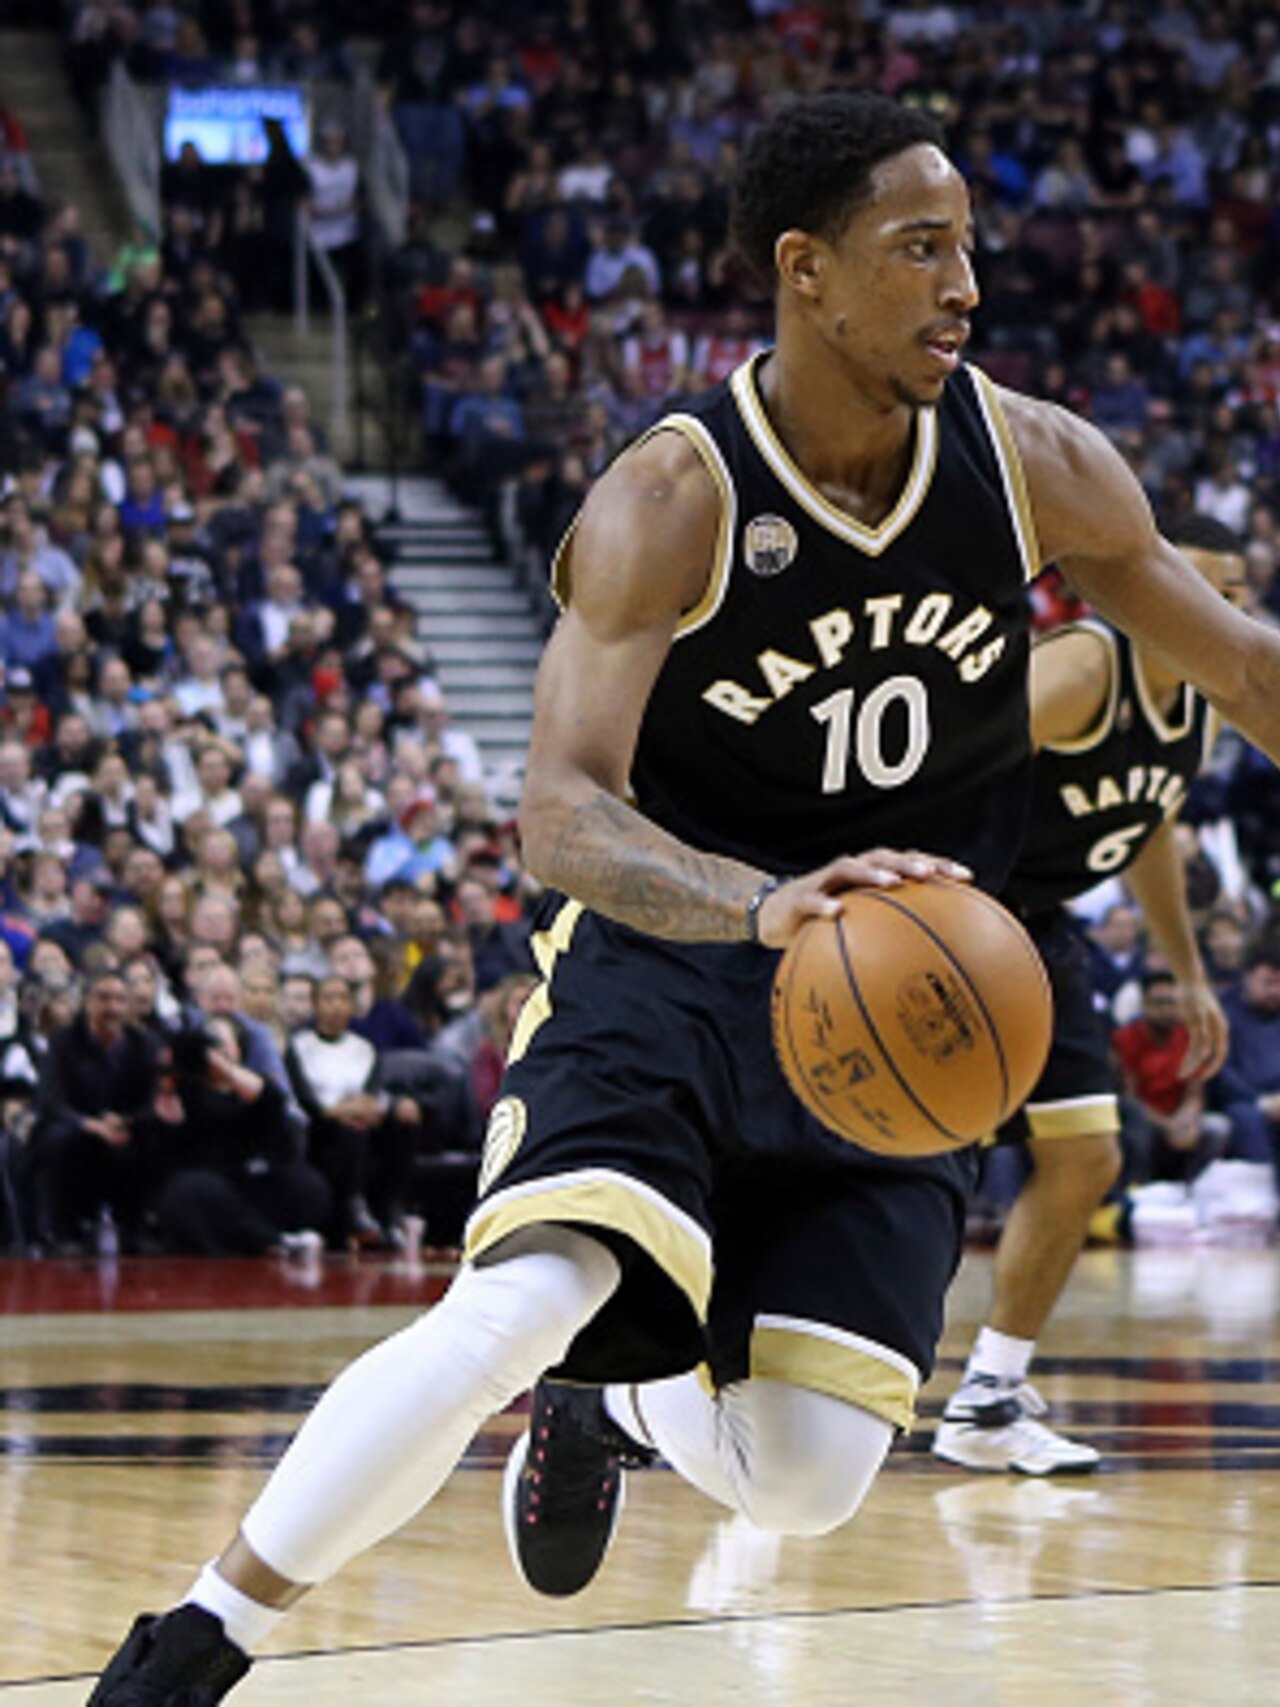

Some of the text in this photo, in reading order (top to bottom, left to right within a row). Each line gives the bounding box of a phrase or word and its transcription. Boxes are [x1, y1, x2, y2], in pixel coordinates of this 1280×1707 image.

[702, 593, 1006, 726] RAPTORS
[809, 675, 931, 794] 10
[1086, 823, 1148, 872] 6
